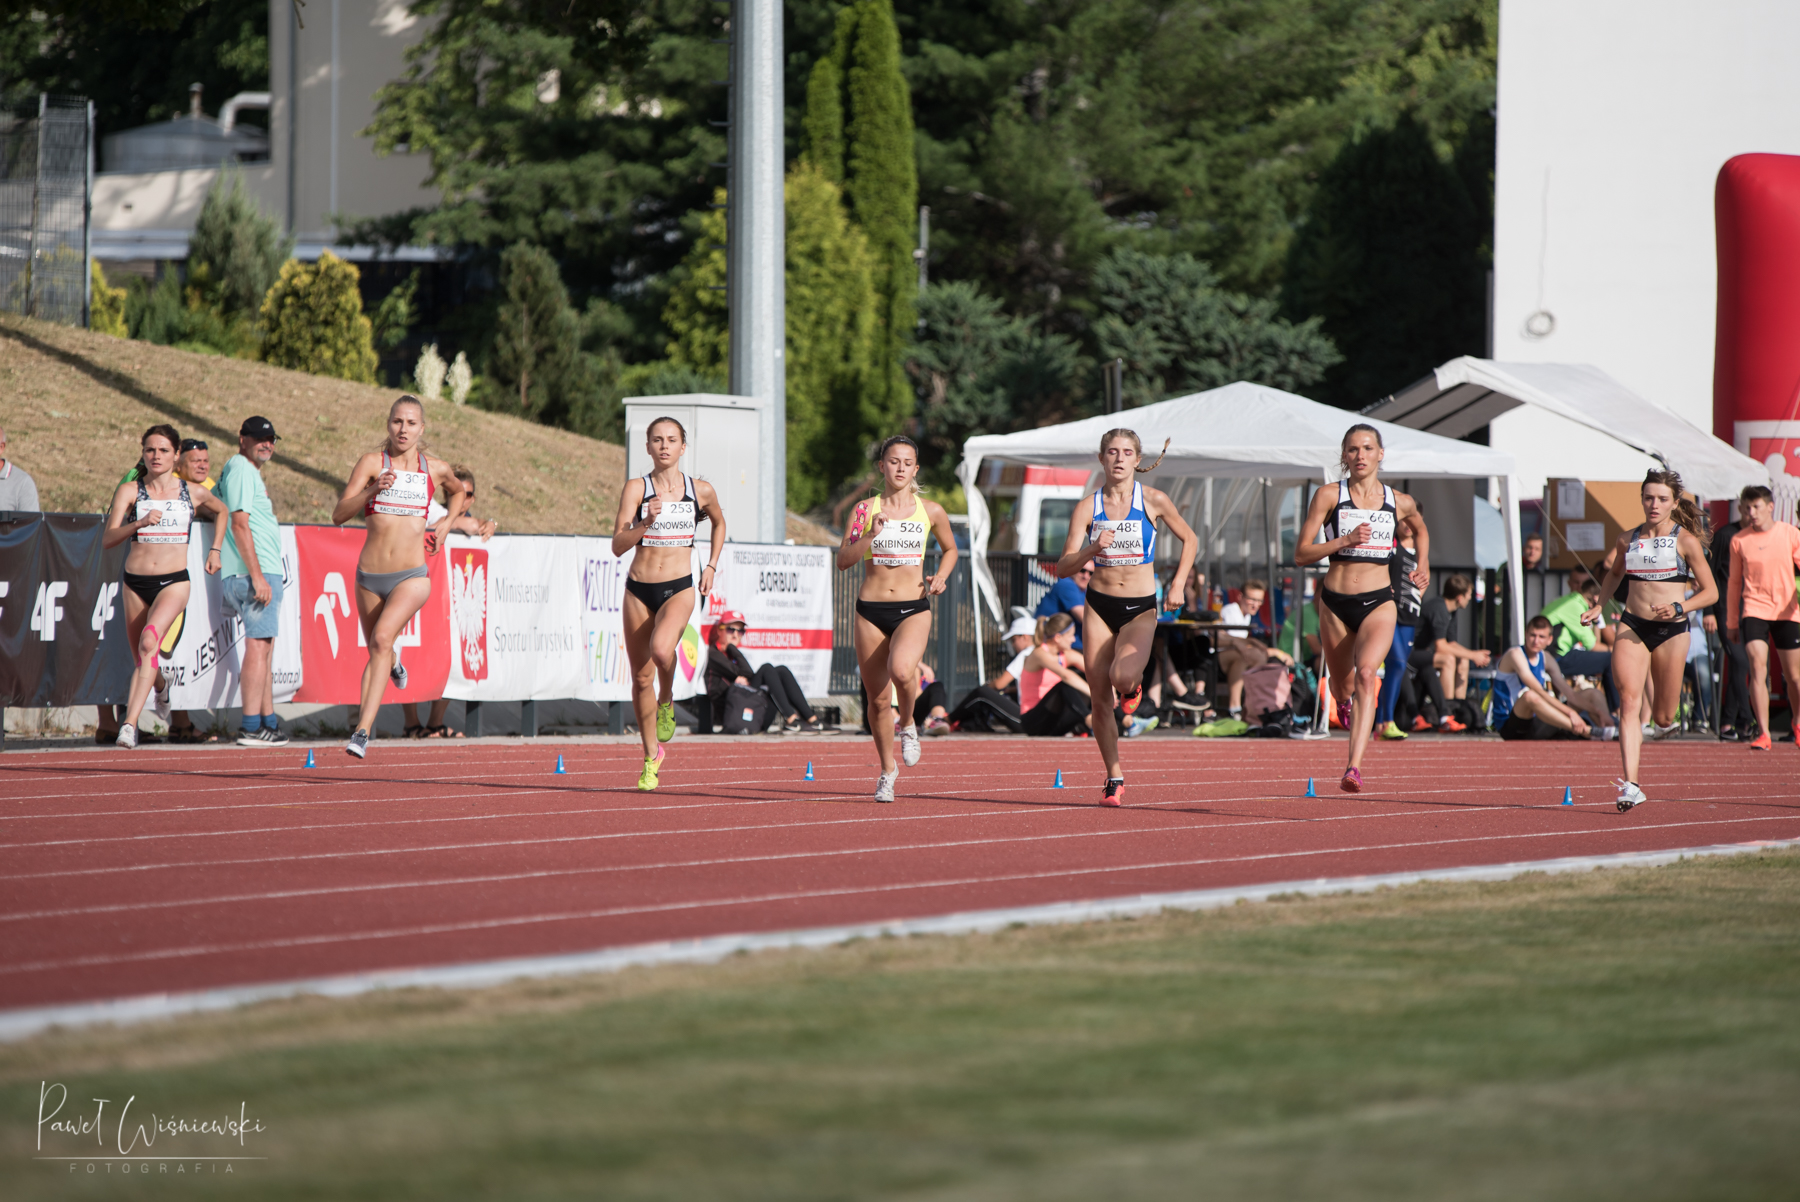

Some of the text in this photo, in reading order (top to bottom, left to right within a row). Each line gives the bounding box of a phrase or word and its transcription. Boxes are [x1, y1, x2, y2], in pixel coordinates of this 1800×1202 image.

[378, 488, 426, 500] ASTRZĘBSKA
[670, 503, 693, 514] 253
[151, 518, 178, 527] RELA
[1369, 512, 1392, 524] 662
[648, 521, 694, 531] RONOWSKA
[900, 522, 923, 533] 526
[1116, 522, 1139, 533] 485
[1340, 528, 1391, 540] SACKA
[873, 538, 921, 549] SKIBIŃSKA
[1653, 538, 1674, 549] 332
[1643, 555, 1657, 564] FIC
[494, 577, 549, 604] Ministerstwo
[30, 581, 68, 641] 4F
[91, 581, 119, 640] 4F
[192, 628, 220, 677] JEST
[220, 617, 233, 648] W
[494, 625, 527, 659] Sportu
[533, 625, 574, 659] Turystyki
